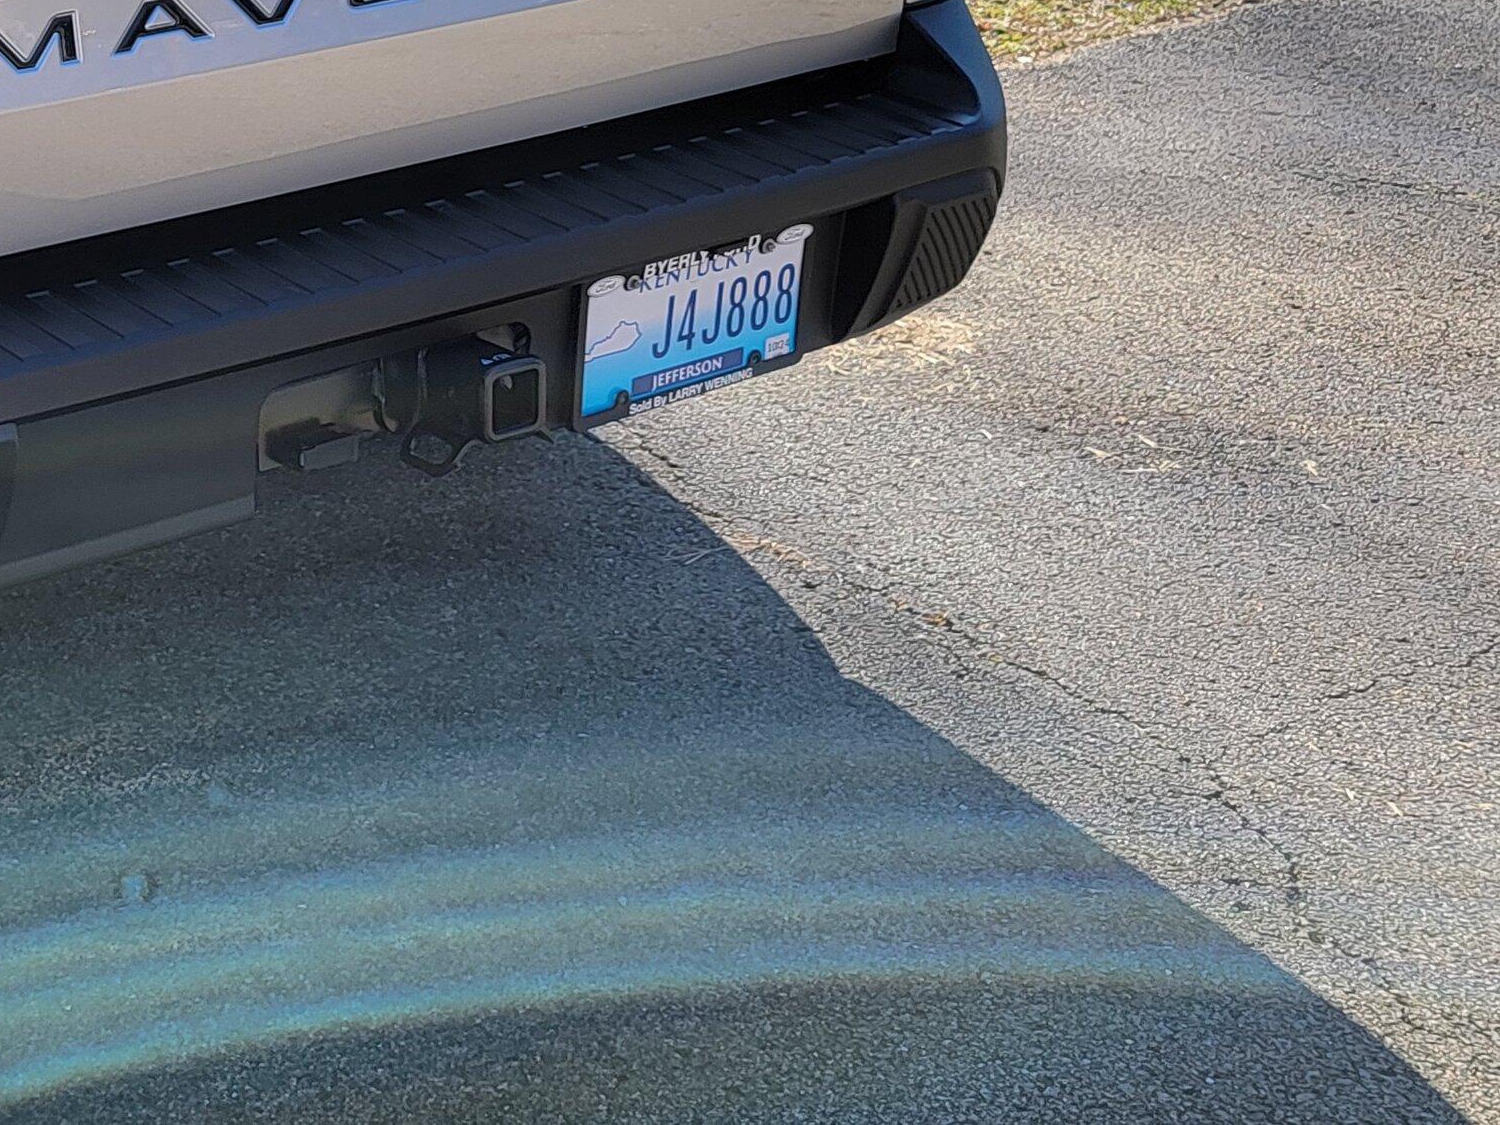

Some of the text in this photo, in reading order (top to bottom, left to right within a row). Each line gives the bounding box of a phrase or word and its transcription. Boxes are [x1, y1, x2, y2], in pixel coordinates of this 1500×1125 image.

[643, 251, 709, 279] BYERLY
[652, 263, 795, 359] J4J888
[628, 367, 753, 415] Sold By LARRY WENNING
[652, 356, 723, 392] JEFFERSON
